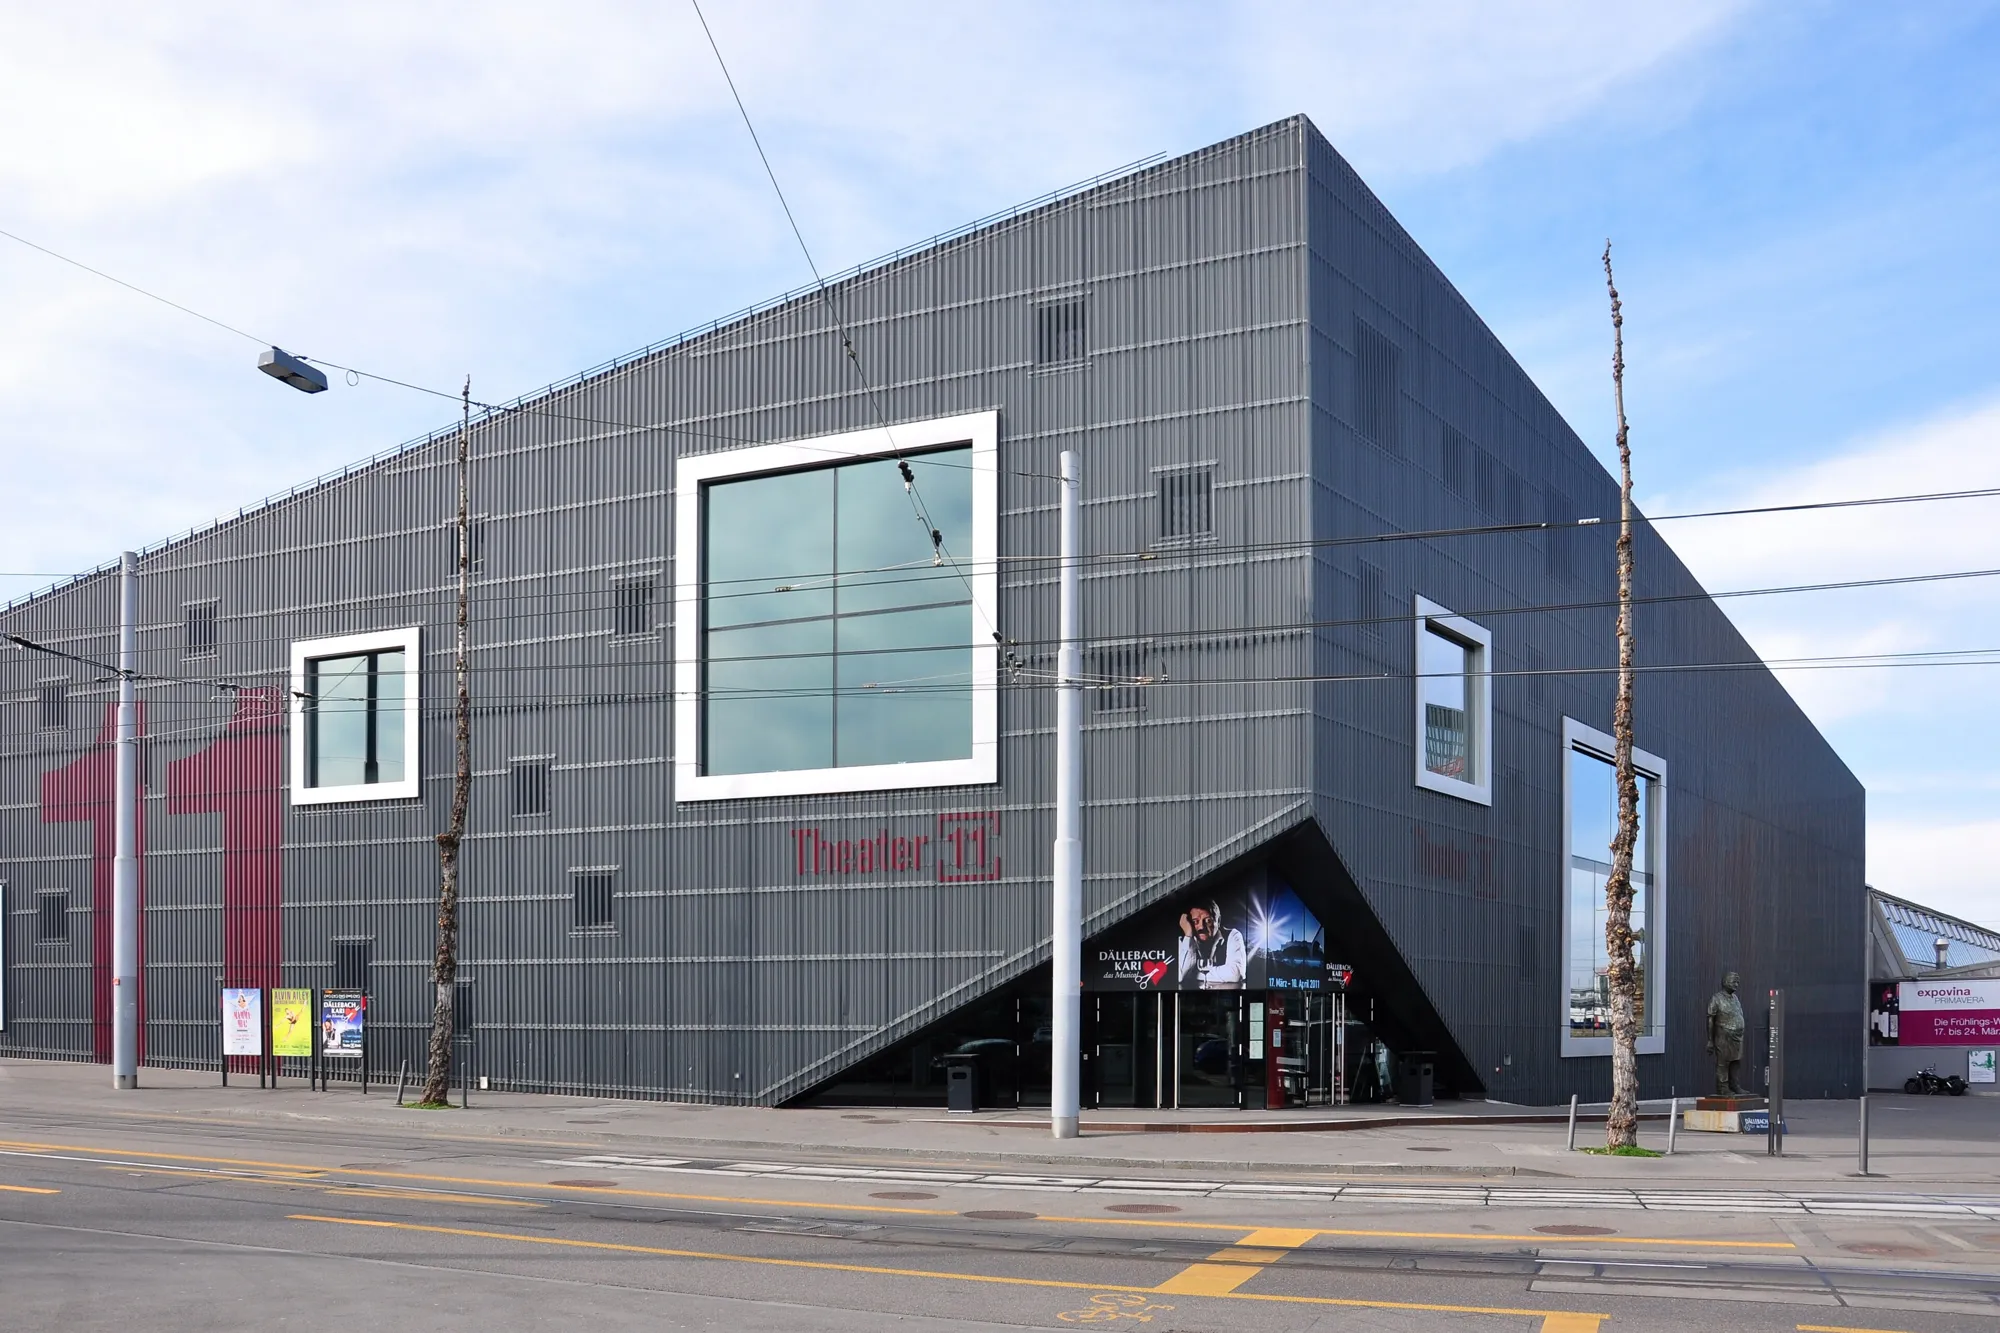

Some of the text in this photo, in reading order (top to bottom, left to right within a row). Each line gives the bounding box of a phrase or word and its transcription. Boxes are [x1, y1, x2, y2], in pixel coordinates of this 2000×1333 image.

[790, 825, 986, 875] Theater 11
[1099, 949, 1166, 961] DÄLLEBACH
[1114, 961, 1142, 971] KARI
[1326, 962, 1352, 971] DÄLLEBACH
[1103, 971, 1140, 979] das Musical
[1275, 977, 1288, 988] März
[1298, 978, 1309, 991] April
[1309, 979, 1320, 989] 2011
[274, 991, 309, 1000] ALVIN AILEY
[1917, 986, 1971, 999] expovina
[1934, 996, 1985, 1004] PRIMAVERA
[1934, 1018, 1948, 1026] Die
[1934, 1027, 1946, 1036] 17.
[1948, 1027, 1962, 1036] bis
[1964, 1027, 1979, 1036] 24.
